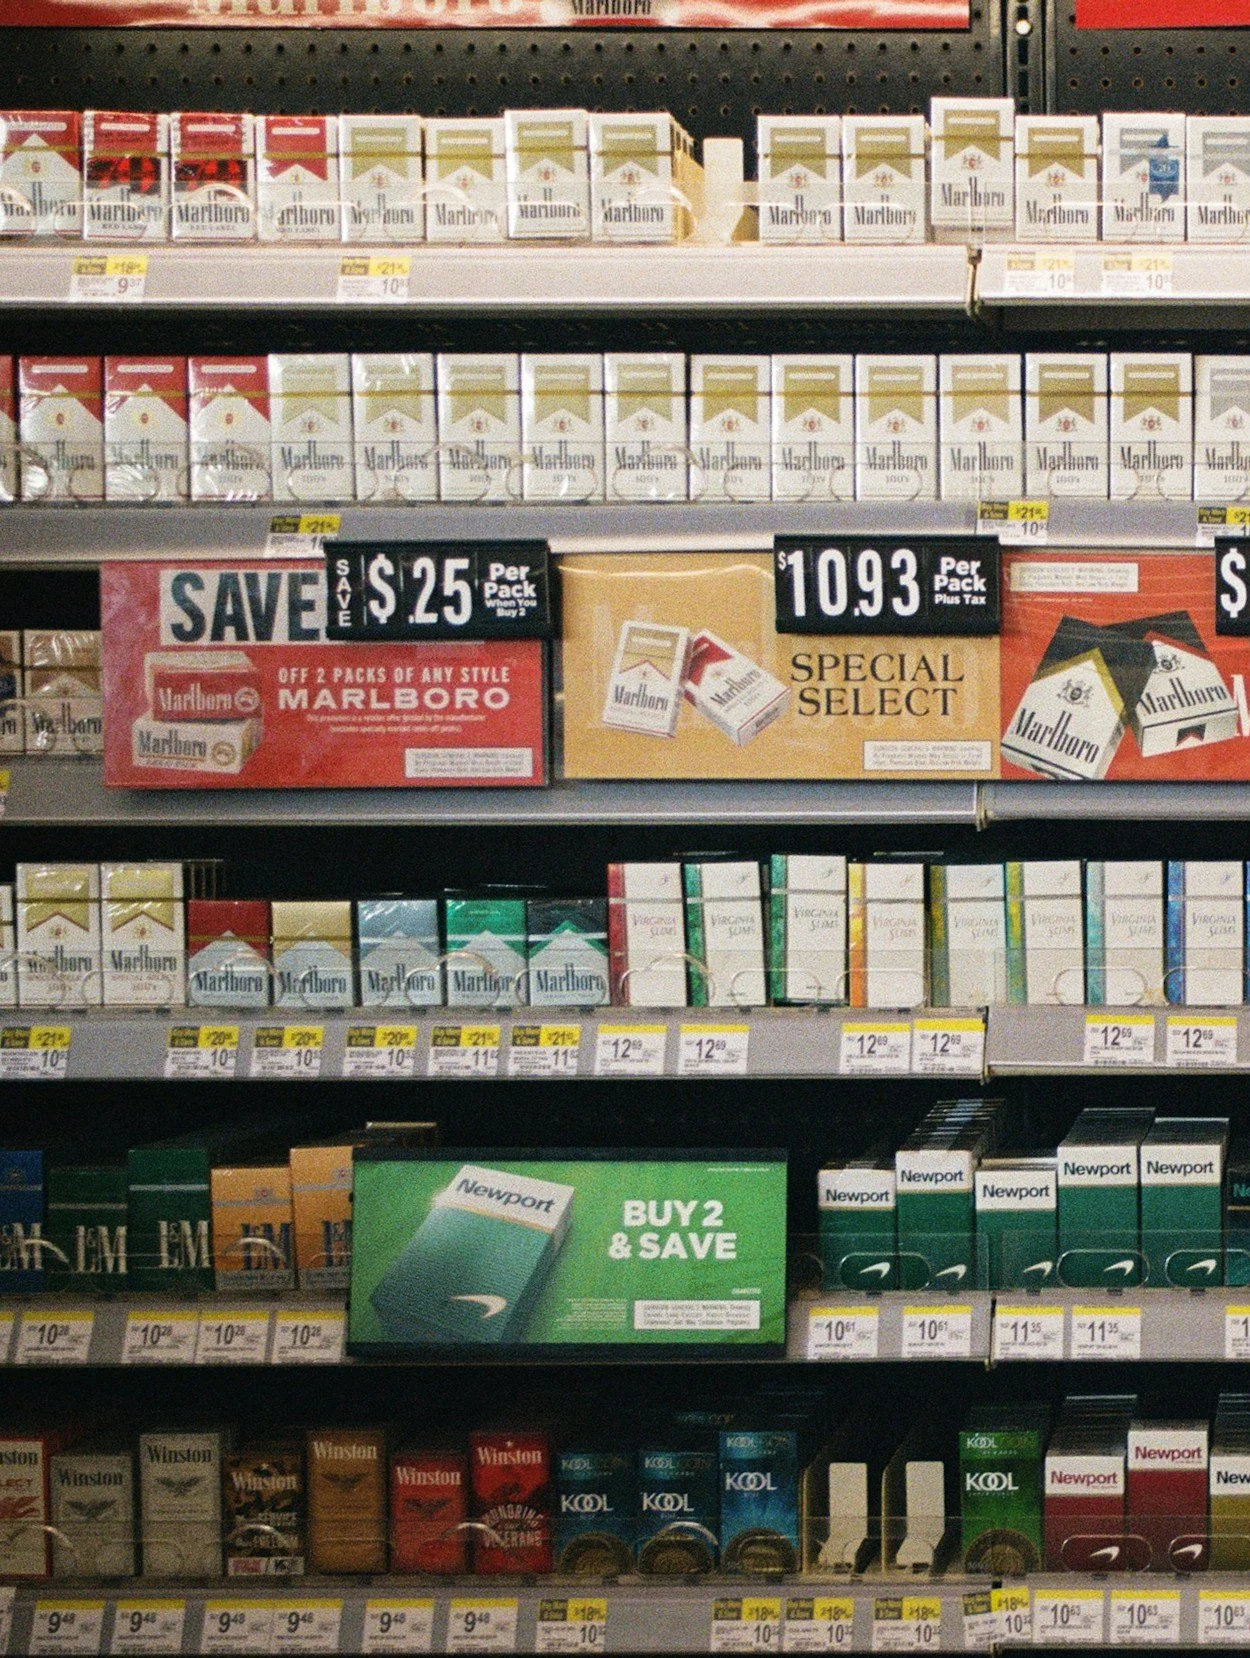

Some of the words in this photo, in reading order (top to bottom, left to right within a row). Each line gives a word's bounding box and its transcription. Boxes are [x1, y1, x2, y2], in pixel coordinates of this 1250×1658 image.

[941, 175, 1005, 210] Marlboro
[1036, 441, 1099, 470] Marlboro
[1120, 440, 1184, 470] Marlboro
[489, 563, 529, 582] Per
[939, 556, 981, 577] Per
[483, 581, 537, 599] Pack
[934, 574, 987, 593] Pack
[335, 561, 352, 628] SAVE
[484, 598, 515, 608] When
[516, 598, 538, 609] You
[935, 593, 961, 605] Plus
[962, 593, 987, 605] Tax
[170, 572, 321, 643] SAVE
[496, 607, 517, 619] Buy
[517, 607, 526, 617] 2
[278, 667, 309, 684] OFF
[316, 667, 326, 684] 2
[333, 667, 387, 684] PACKS
[393, 667, 414, 684] OF
[421, 667, 454, 684] ANY
[460, 667, 511, 684] STYLE
[790, 653, 965, 682] SPECIAL
[158, 679, 233, 711] Marlboro
[278, 687, 511, 711] MARLBORO
[613, 683, 670, 714] Marlboro
[799, 687, 958, 717] SELECT
[1138, 676, 1229, 716] Marlboro
[136, 725, 208, 759] Marlboro
[1010, 706, 1100, 766] Marlboro
[197, 965, 263, 995] Marlboro
[537, 964, 605, 994] Marlboro
[900, 1168, 964, 1186] Newport
[1064, 1160, 1132, 1178] Newport
[1146, 1159, 1215, 1176] Newport
[454, 1176, 556, 1214] Newport
[826, 1188, 889, 1205] Newport
[982, 1183, 1050, 1201] Newport
[623, 1199, 698, 1227] BUY
[702, 1200, 724, 1227] 2
[608, 1232, 632, 1259] &
[639, 1232, 738, 1260] SAVE
[146, 1444, 212, 1464] Winston
[312, 1440, 378, 1459] Winston
[477, 1445, 542, 1466] Winston
[1134, 1444, 1202, 1463] Newport
[56, 1468, 123, 1487] Winston
[230, 1469, 298, 1491] Winston
[394, 1466, 461, 1486] Winston
[725, 1471, 777, 1492] KOOL
[965, 1471, 1018, 1492] KOOL
[1051, 1469, 1117, 1487] Newport
[560, 1492, 612, 1512] KOOL
[642, 1492, 695, 1513] KOOL
